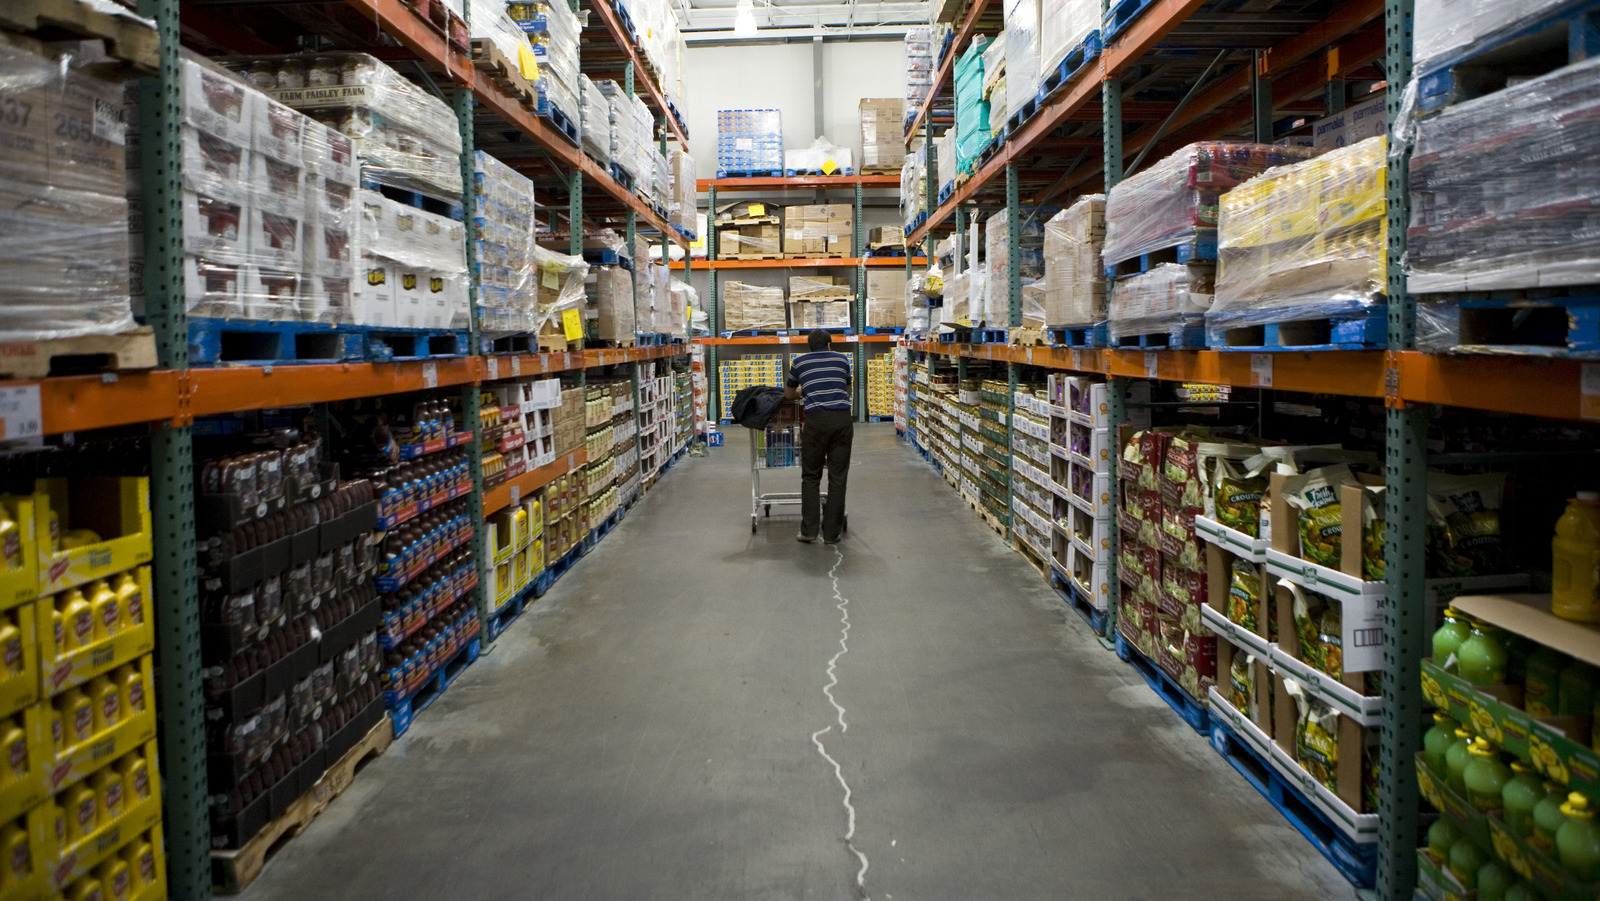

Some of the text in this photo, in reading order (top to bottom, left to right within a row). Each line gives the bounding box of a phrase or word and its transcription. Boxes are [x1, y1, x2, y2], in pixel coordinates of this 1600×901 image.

[280, 91, 302, 101] FARM
[306, 87, 365, 99] PAISLEY FARM
[1353, 99, 1386, 123] parmalat
[1317, 115, 1345, 138] parmalat
